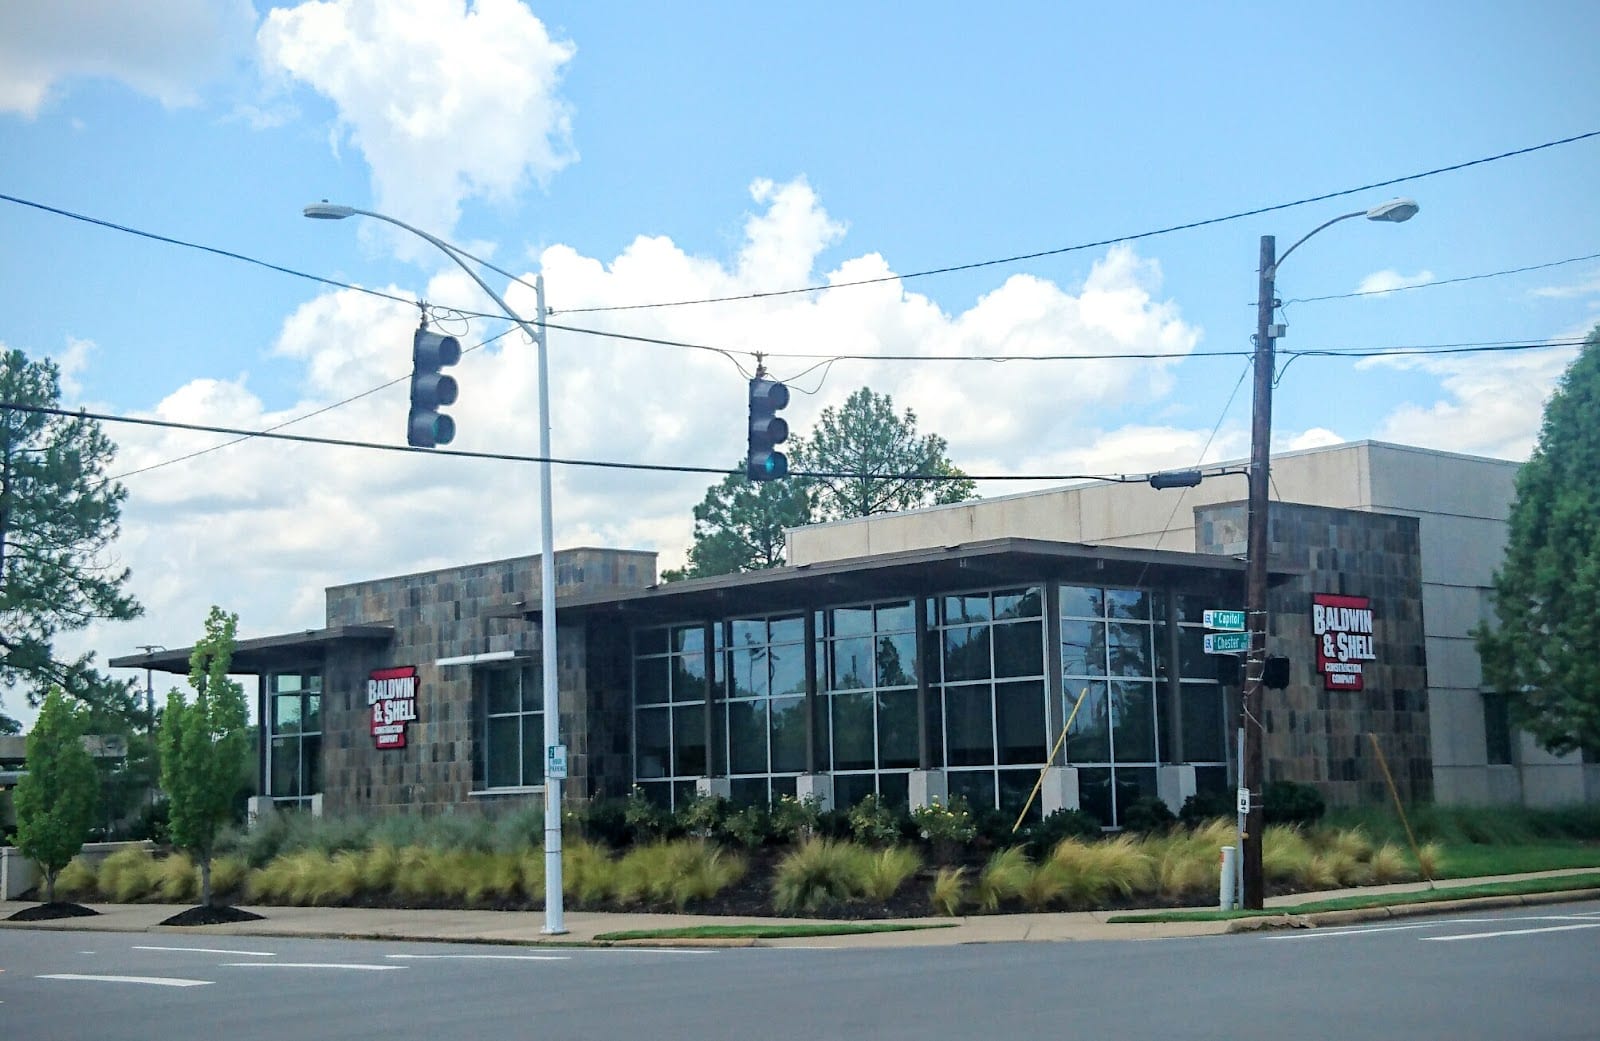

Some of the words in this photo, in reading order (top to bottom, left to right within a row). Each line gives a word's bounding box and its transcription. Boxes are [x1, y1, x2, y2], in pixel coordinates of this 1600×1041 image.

[1218, 612, 1240, 627] Capitol
[1313, 604, 1372, 634] BALDWIN
[1217, 636, 1239, 650] Chester
[1323, 633, 1336, 657] &
[1337, 632, 1376, 662] SHELL
[1325, 662, 1362, 673] CONSTRUCTION
[1331, 673, 1356, 684] COMPANY
[368, 677, 414, 705] BALDWIN
[374, 702, 383, 722] &
[384, 700, 416, 724] SHELL
